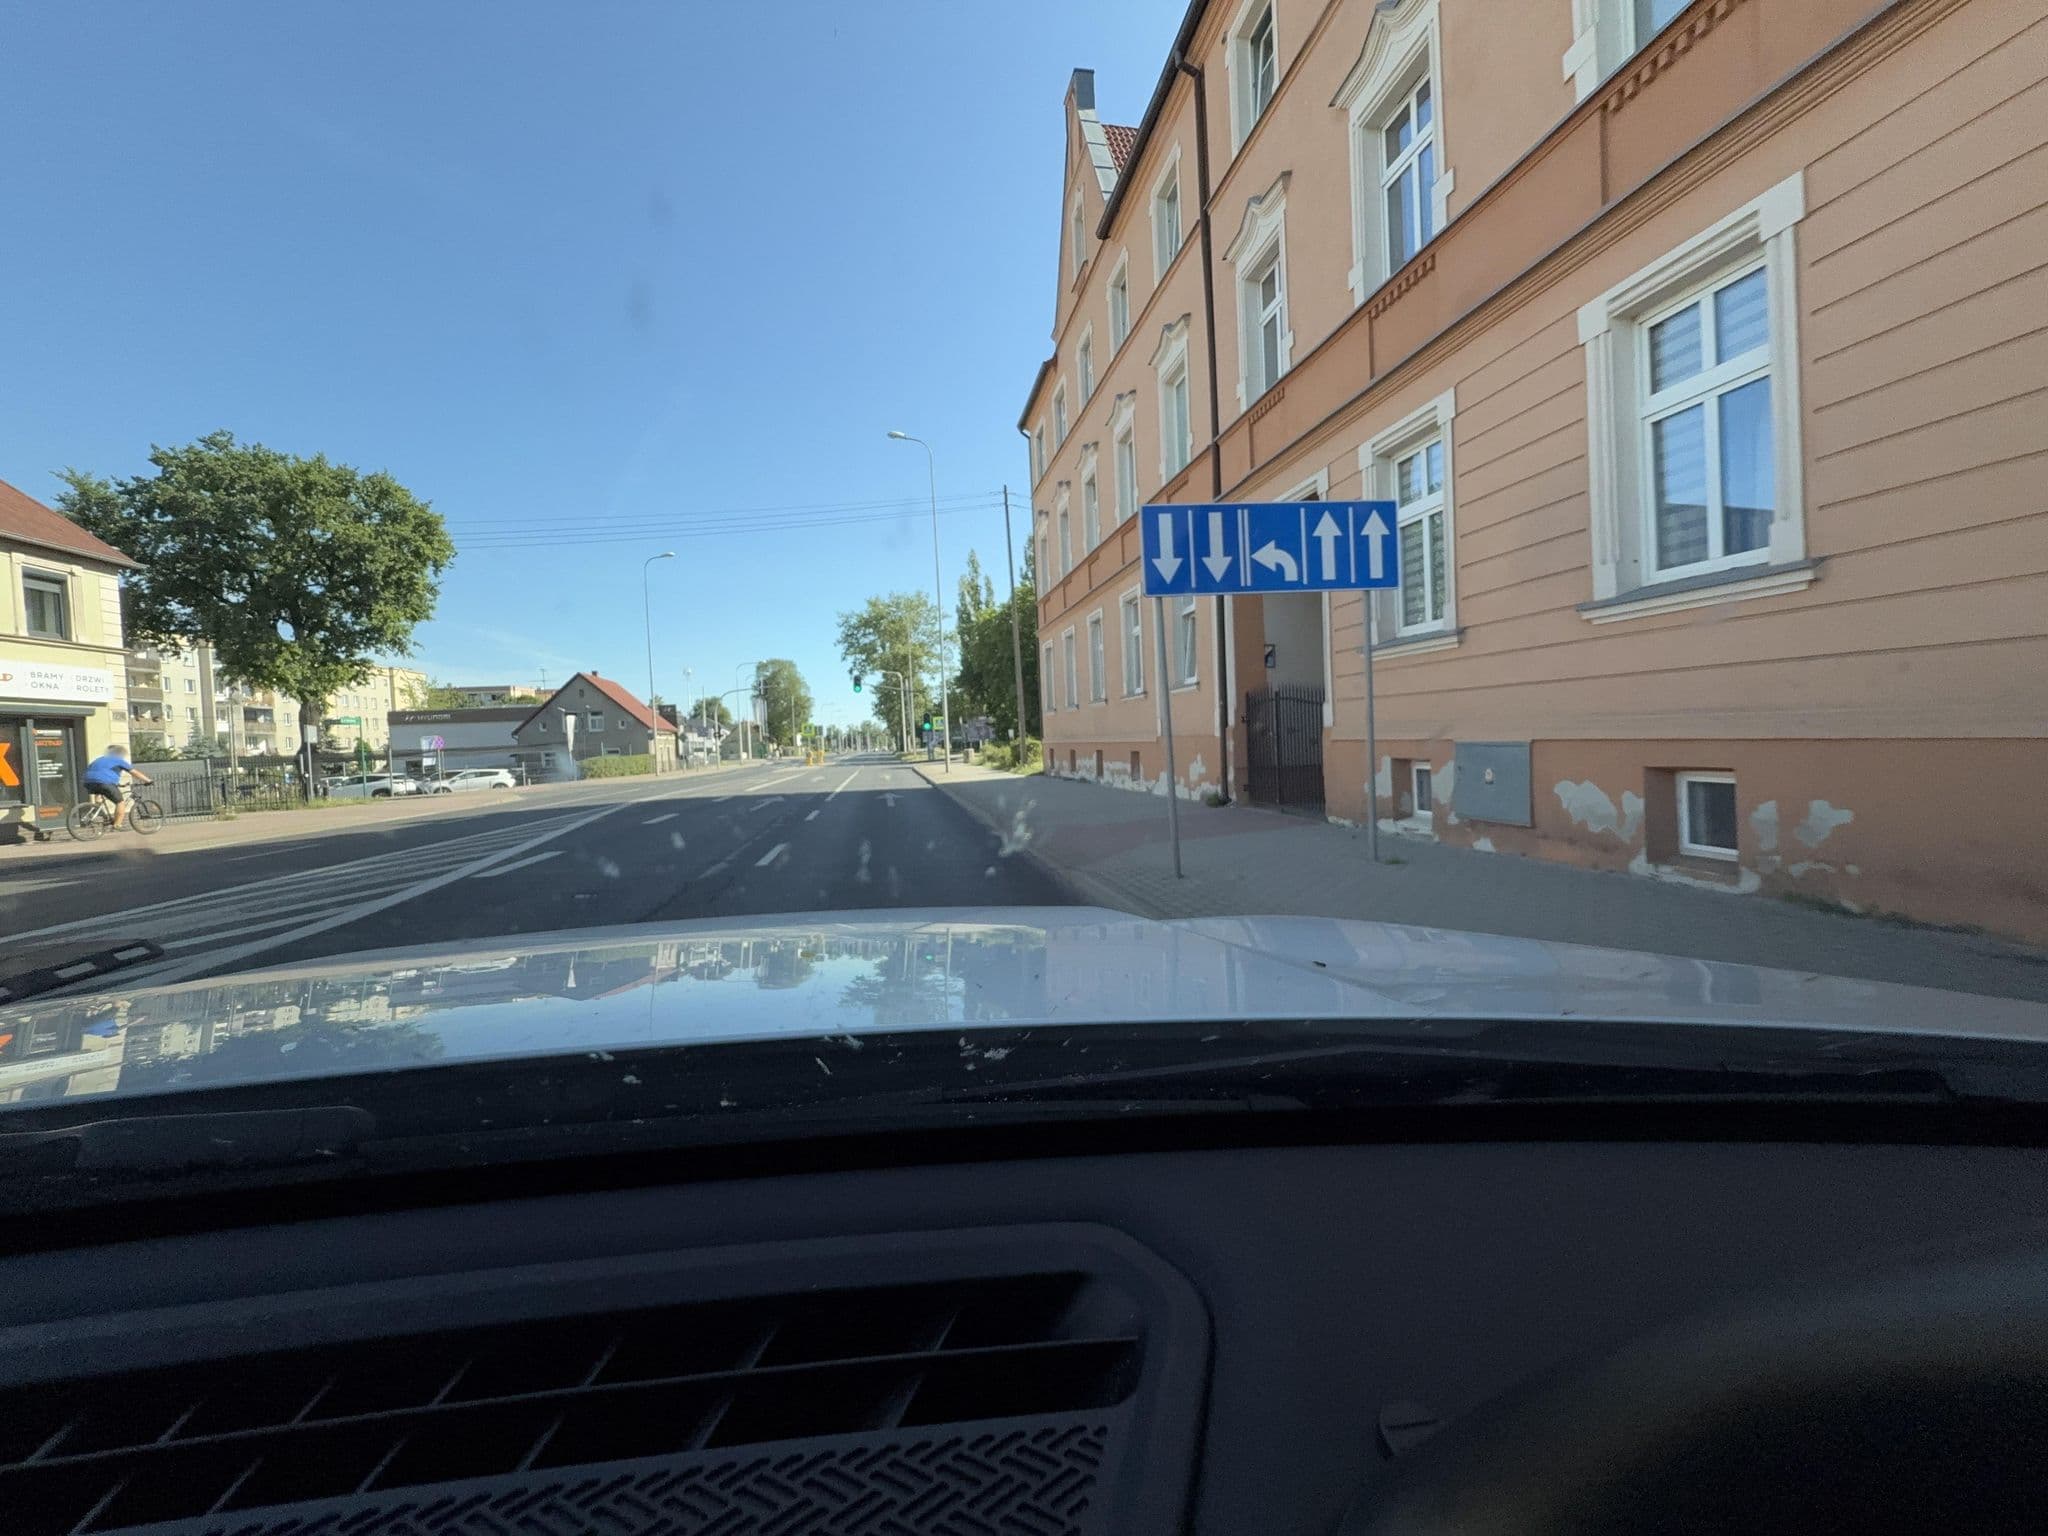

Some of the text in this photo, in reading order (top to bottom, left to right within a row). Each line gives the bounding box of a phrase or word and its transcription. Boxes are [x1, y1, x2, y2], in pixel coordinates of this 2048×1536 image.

[30, 671, 105, 683] BRAMY DRZWI
[30, 681, 109, 693] OKNA ROLETY
